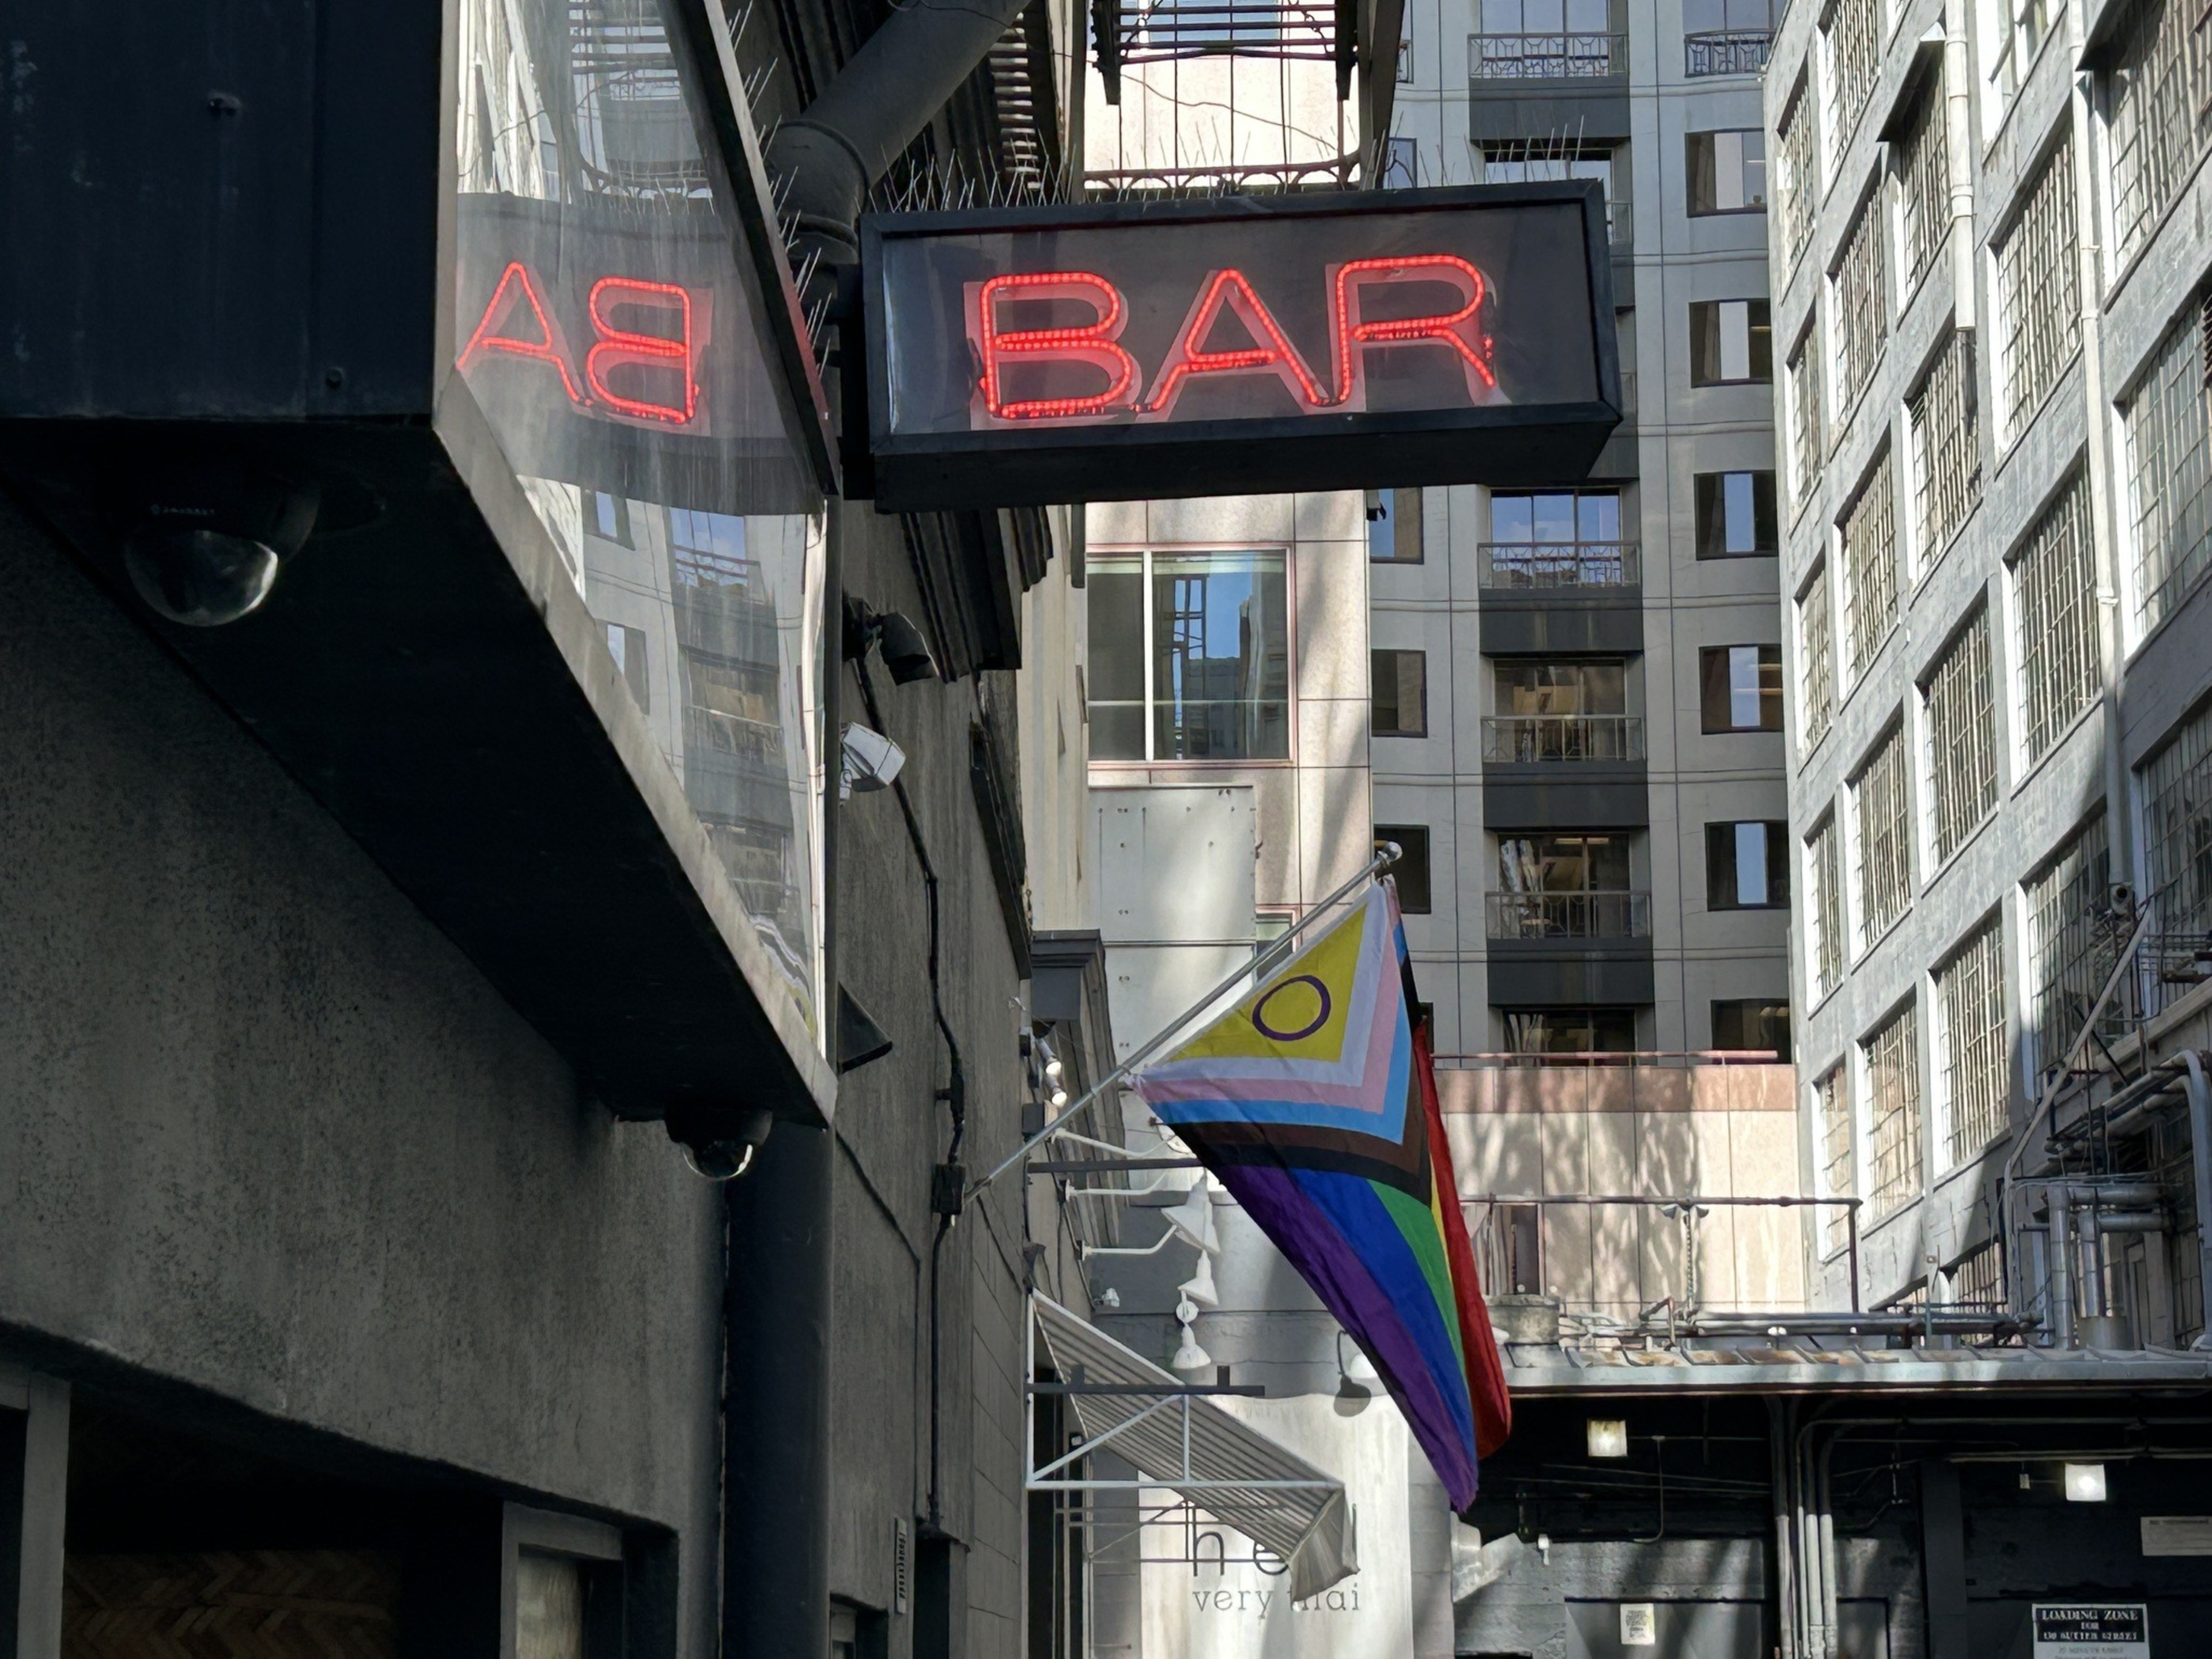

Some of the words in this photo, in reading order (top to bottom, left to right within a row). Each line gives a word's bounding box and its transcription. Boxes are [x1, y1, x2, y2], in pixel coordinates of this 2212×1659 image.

[966, 254, 1508, 429] BAR
[1192, 1589, 1276, 1619] very
[2041, 1609, 2098, 1620] LOADING
[2104, 1609, 2139, 1620] ZONE
